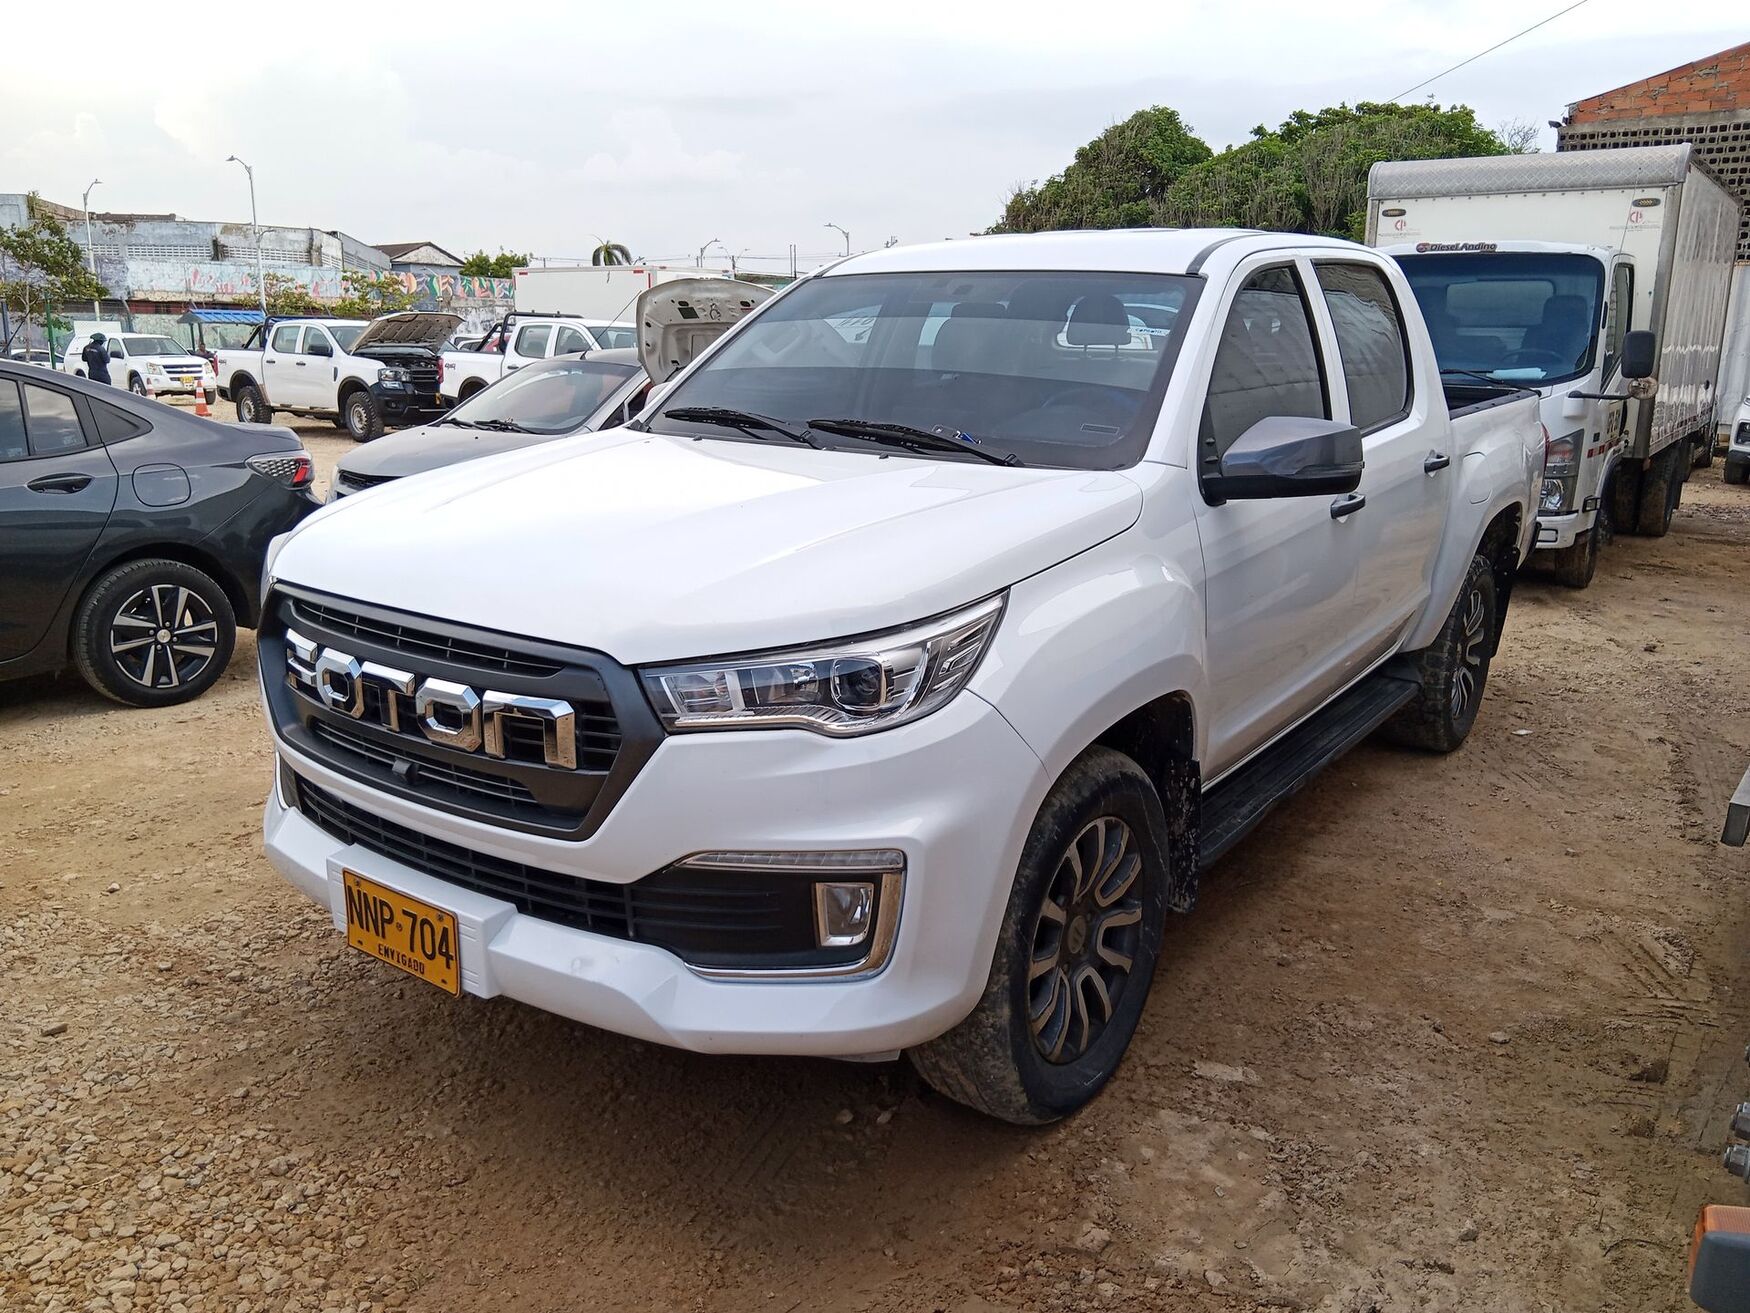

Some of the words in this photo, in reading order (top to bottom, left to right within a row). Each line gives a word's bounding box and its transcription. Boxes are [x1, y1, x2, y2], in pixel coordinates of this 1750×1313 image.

[1460, 241, 1498, 251] Andino
[346, 884, 395, 940] NNP
[401, 907, 454, 970] 704
